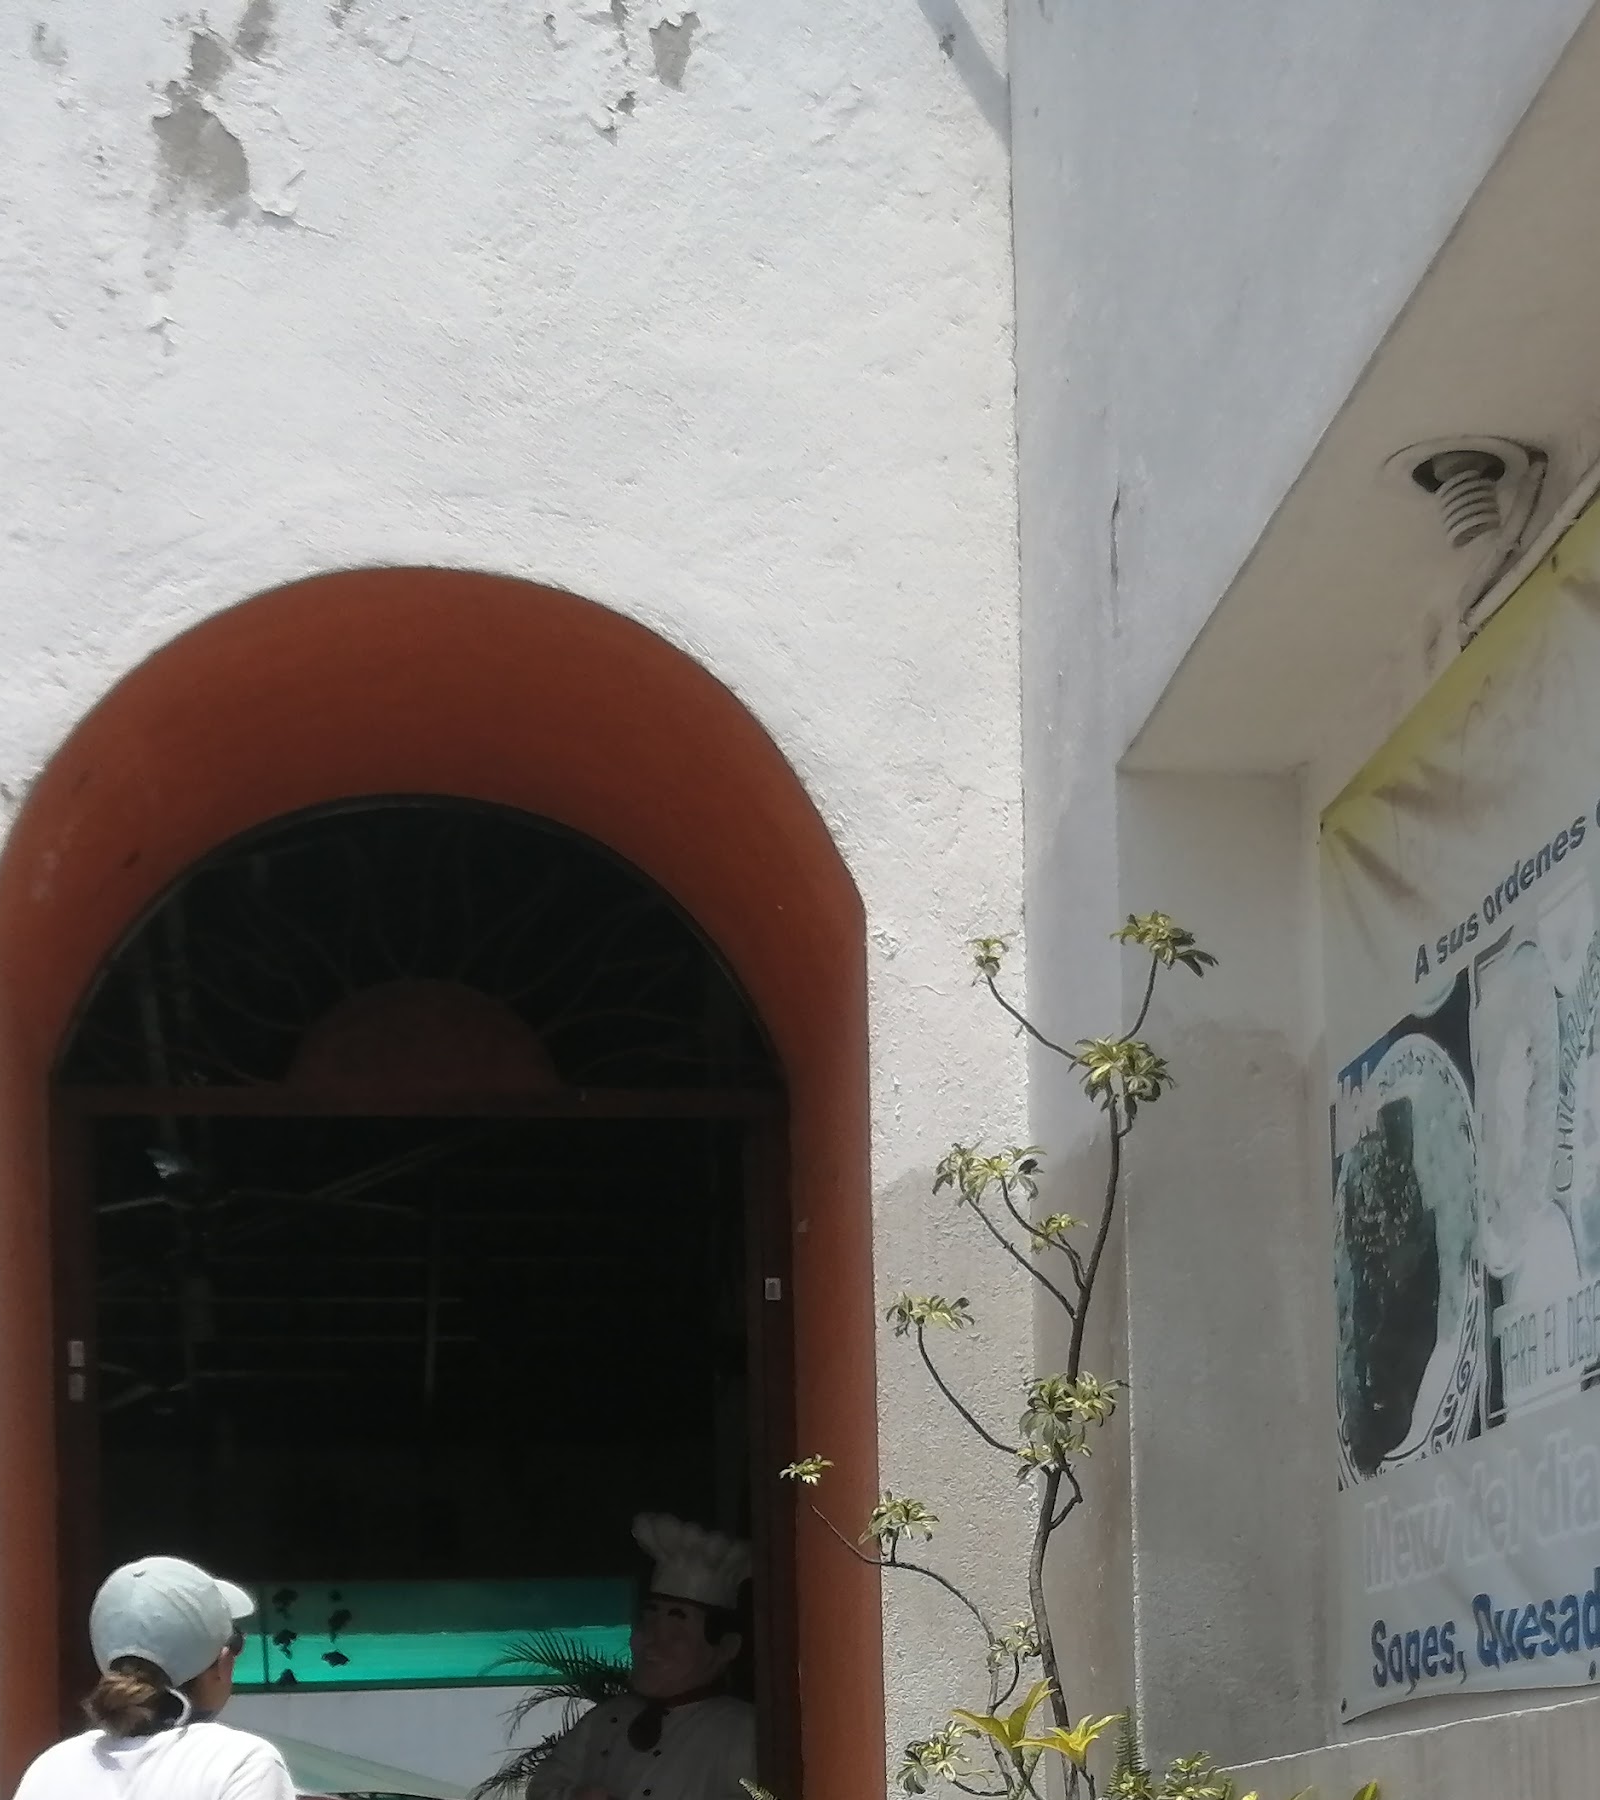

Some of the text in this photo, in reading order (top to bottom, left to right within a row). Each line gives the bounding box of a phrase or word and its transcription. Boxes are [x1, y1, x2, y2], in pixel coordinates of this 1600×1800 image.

[1414, 943, 1431, 985] A
[1436, 911, 1480, 966] sus
[1482, 814, 1588, 927] ordenes
[1370, 1618, 1468, 1696] Sopes,
